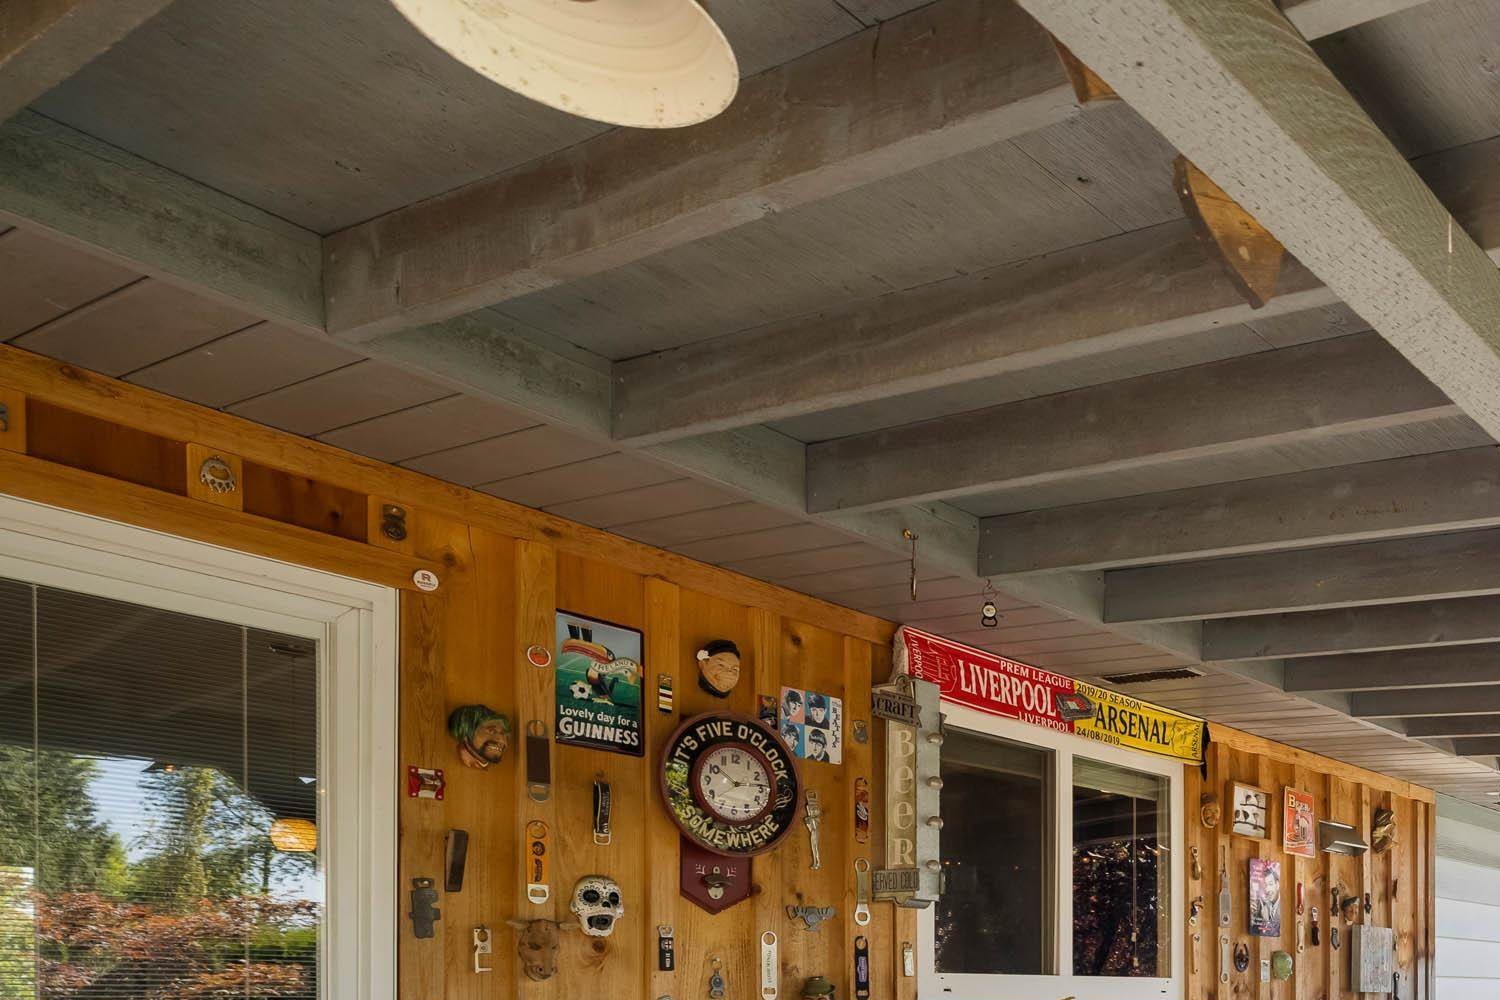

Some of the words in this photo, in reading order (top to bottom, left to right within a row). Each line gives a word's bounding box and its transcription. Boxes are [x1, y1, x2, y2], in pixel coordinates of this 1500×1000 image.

[908, 634, 923, 679] LIVERPOO
[1000, 660, 1029, 678] PREM
[1032, 670, 1072, 689] LEAGUE
[957, 659, 1057, 717] LIVERPOOL
[1076, 683, 1108, 701] 2019/20
[1109, 693, 1143, 711] SEASON
[559, 704, 594, 721] Lovely
[597, 711, 615, 725] day
[617, 715, 631, 726] for
[632, 719, 638, 728] a
[1018, 711, 1071, 733] LIVERPOOL
[1094, 701, 1171, 746] ARSENAL
[559, 716, 639, 746] GUINNESS
[1076, 726, 1120, 746] 24/08/2019
[696, 721, 734, 742] FIVE
[737, 724, 789, 781] O'CLOCK
[731, 754, 740, 765] 12
[704, 775, 712, 786] 9
[709, 764, 720, 775] 10
[754, 771, 760, 781] 2
[683, 805, 780, 848] SOMEWHERE
[875, 871, 898, 890] ERVED
